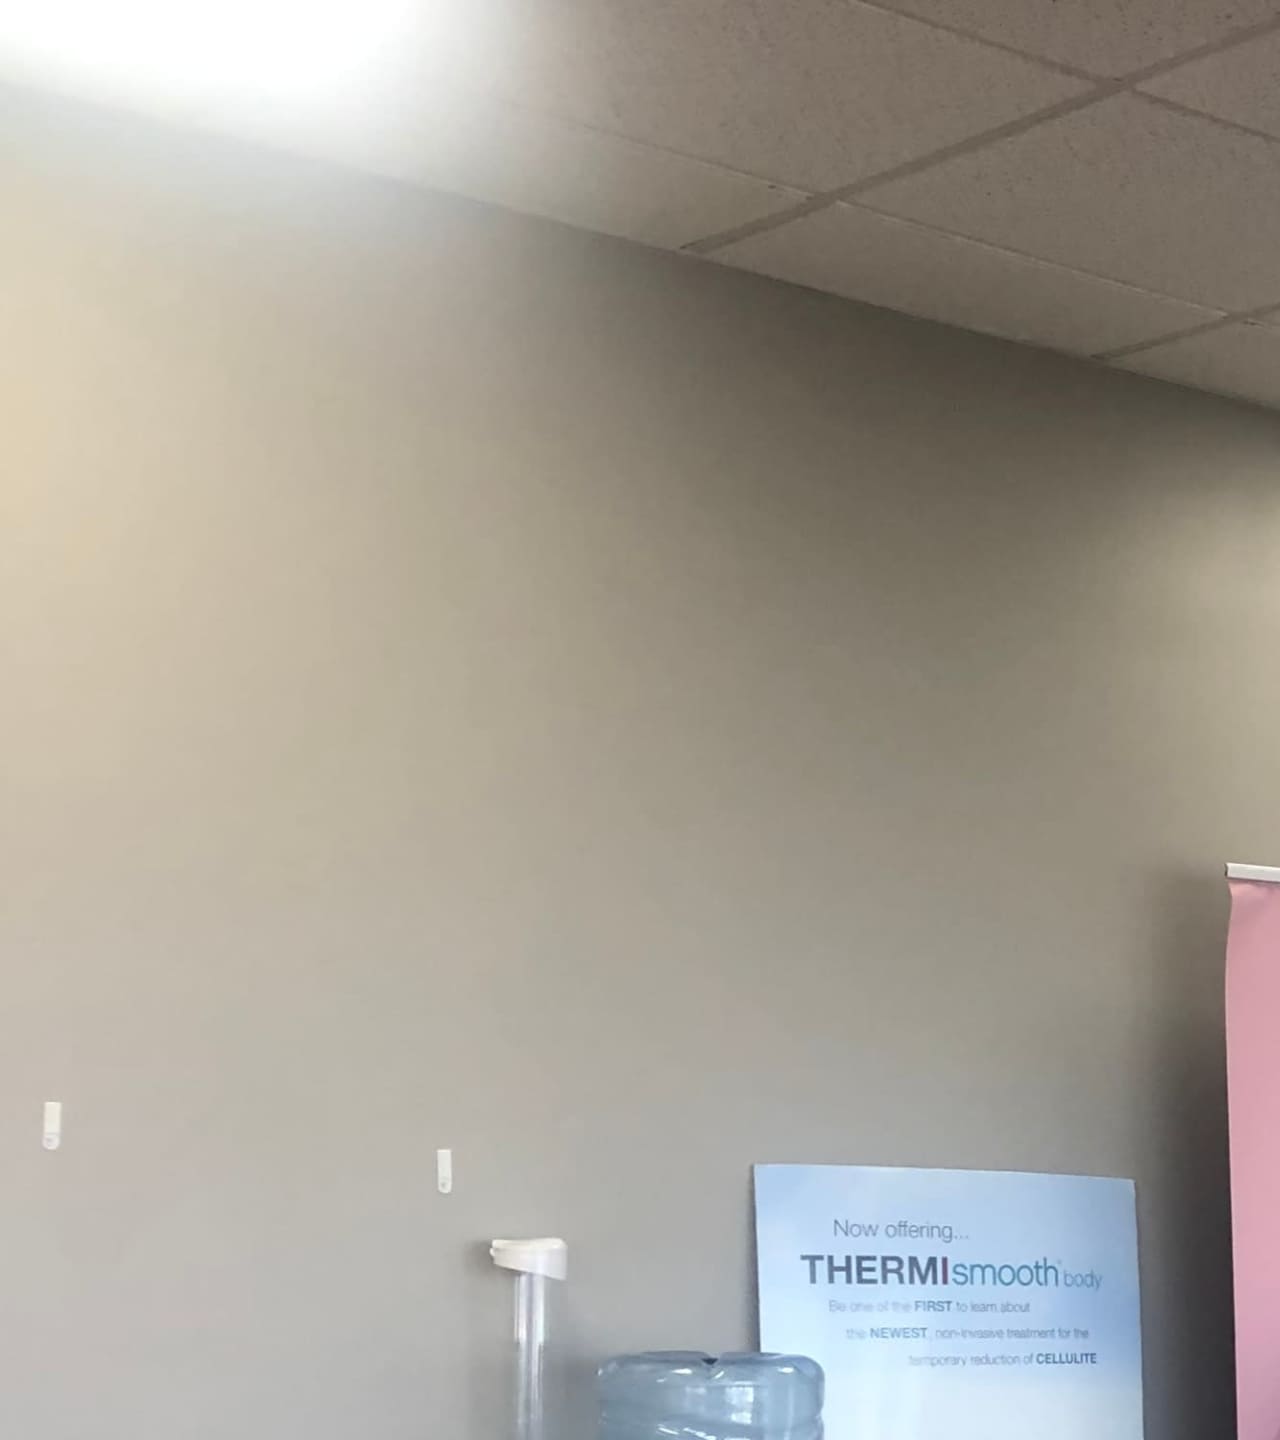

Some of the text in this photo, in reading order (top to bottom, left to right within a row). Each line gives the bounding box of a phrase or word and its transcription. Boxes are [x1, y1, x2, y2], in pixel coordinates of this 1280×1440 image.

[833, 1219, 879, 1239] Now
[1063, 1269, 1102, 1291] body
[915, 1300, 952, 1312] FIRST
[956, 1301, 967, 1312] to
[970, 1300, 997, 1312] learn
[1000, 1301, 1030, 1313] about
[935, 1328, 1003, 1339] non-invasive
[1006, 1327, 1055, 1339] treatment
[1058, 1327, 1071, 1339] for
[1073, 1327, 1089, 1339] the
[908, 1352, 1097, 1367] temporary reduction of CELLULITE
